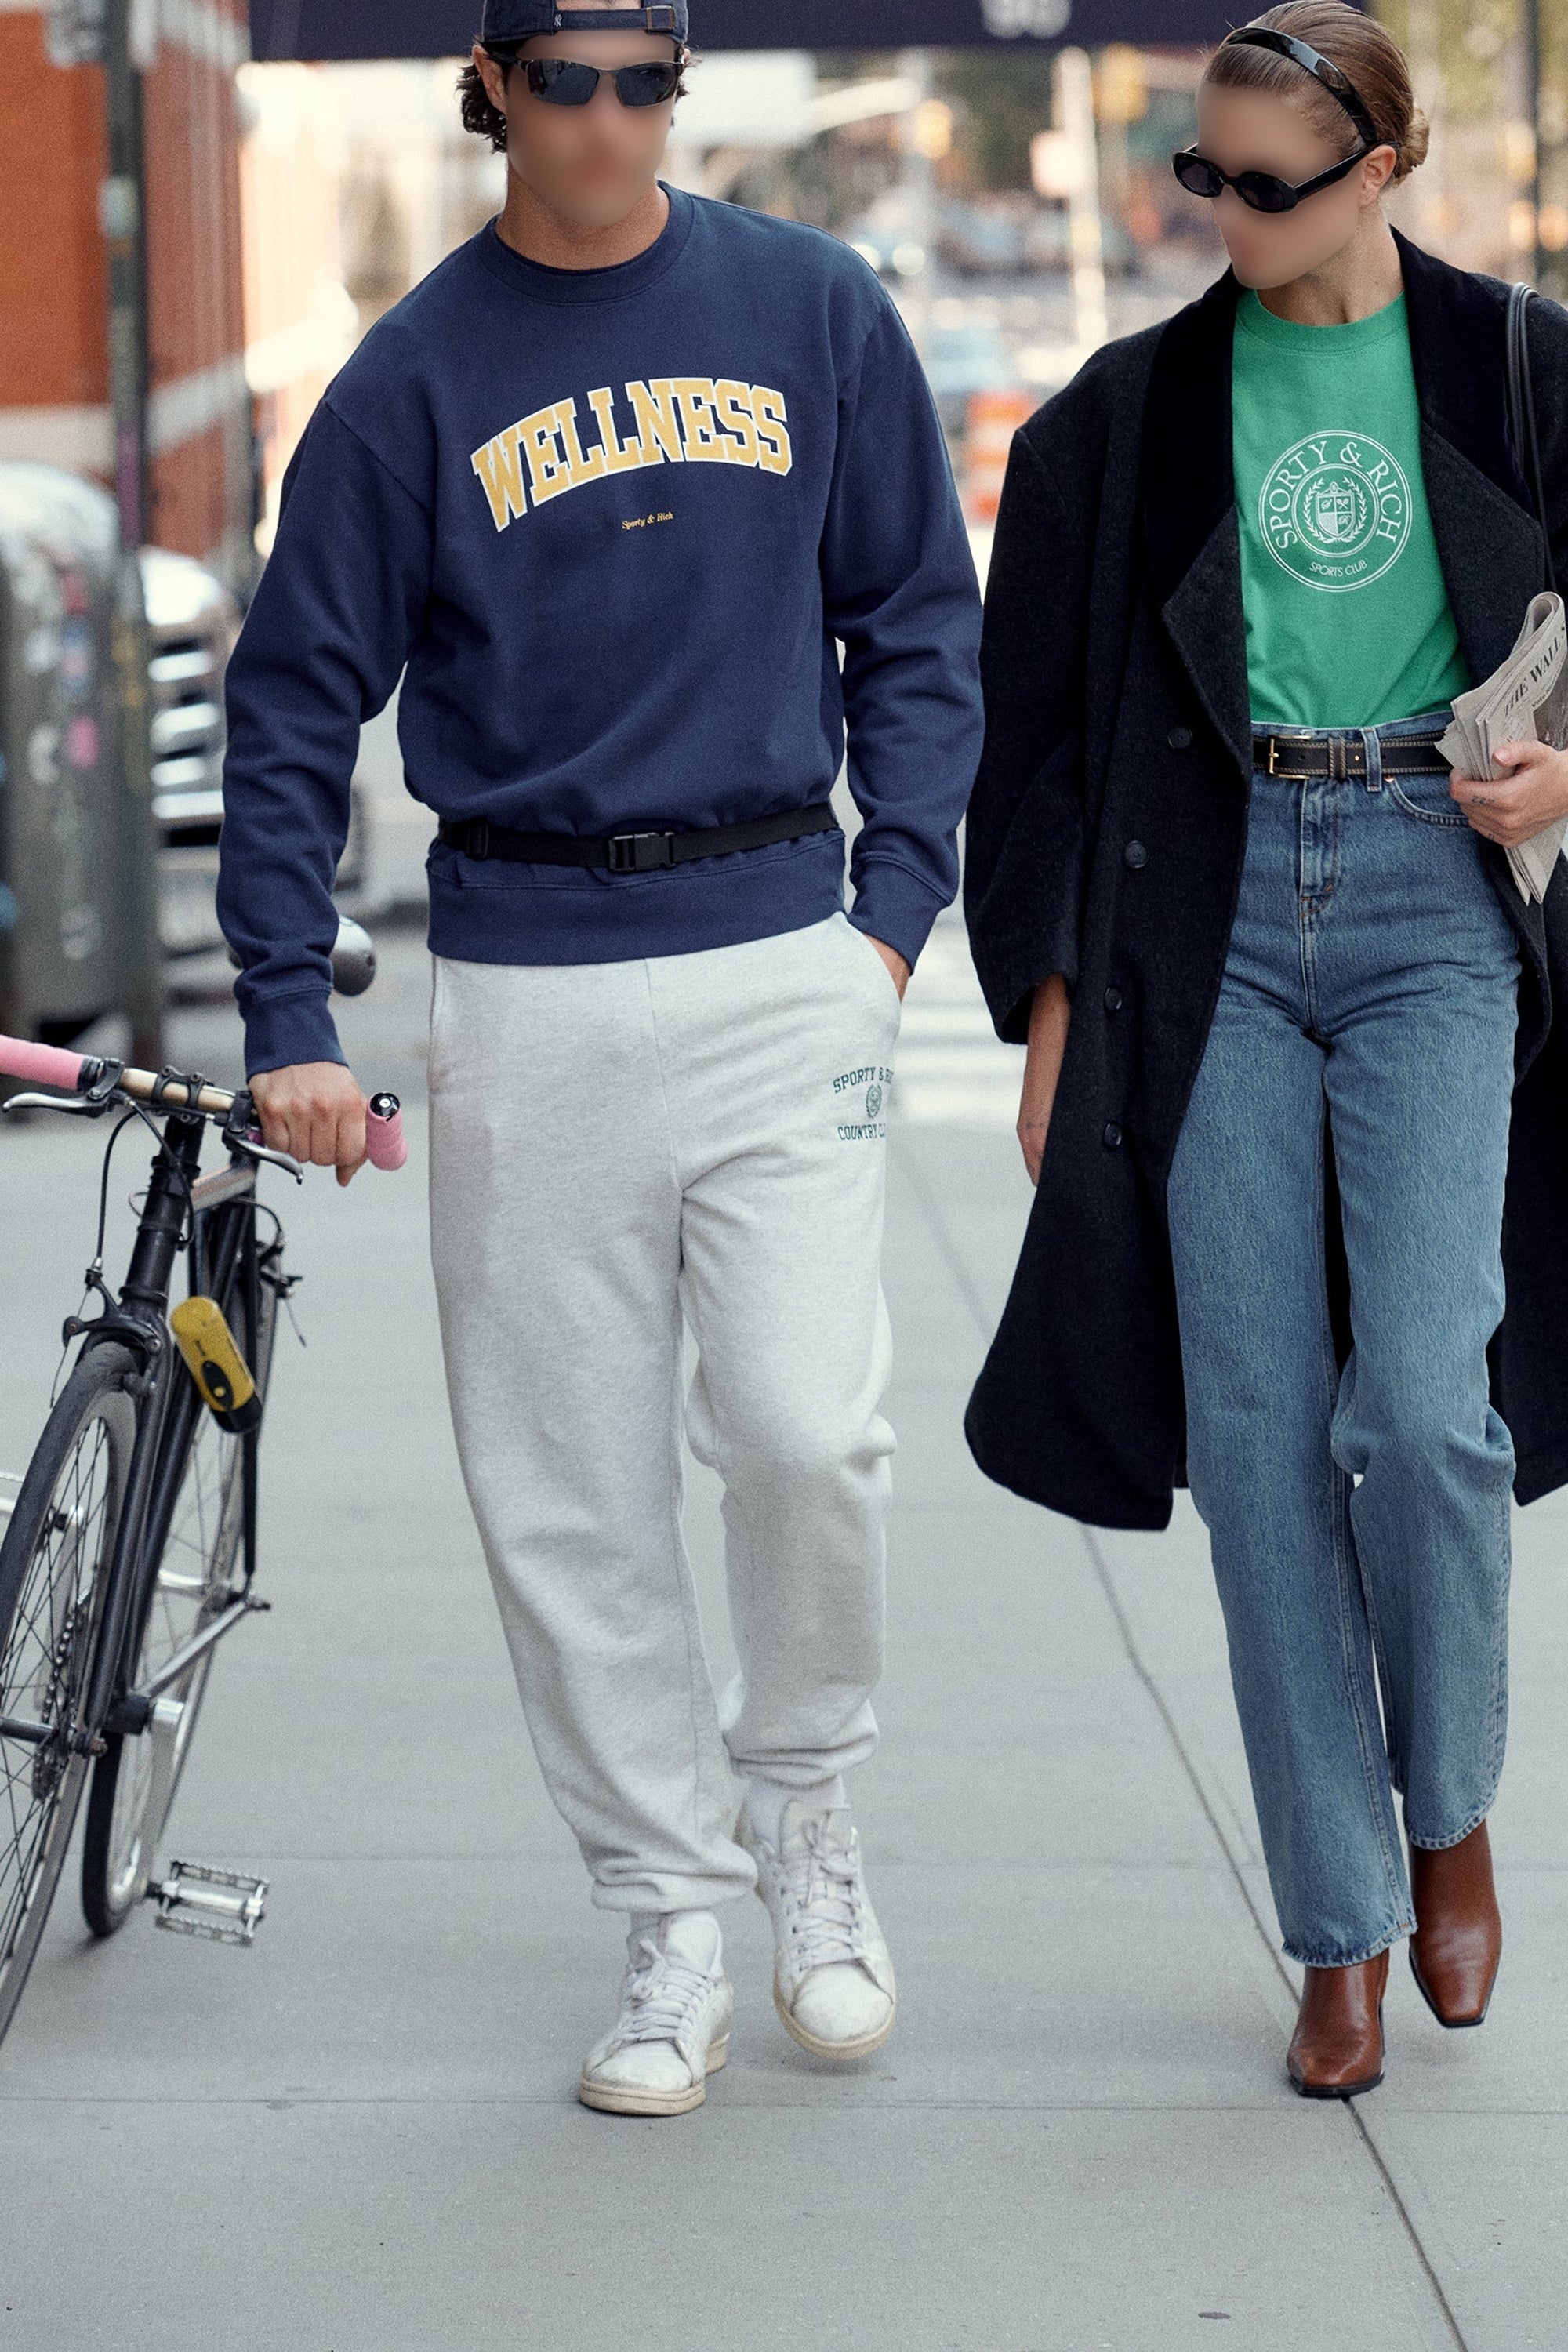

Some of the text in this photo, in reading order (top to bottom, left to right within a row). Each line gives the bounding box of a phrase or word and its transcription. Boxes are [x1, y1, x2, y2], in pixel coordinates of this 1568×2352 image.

[470, 378, 793, 532] WELLNESS
[1269, 441, 1403, 550] SPORTY & RICH
[622, 511, 673, 530] Sporty & Rich
[1308, 560, 1367, 577] SPORTS CLUB
[1504, 677, 1529, 716] THE
[1530, 637, 1560, 682] WALL
[833, 1066, 876, 1094] SPORTY
[837, 1123, 877, 1141] COUNTRY
